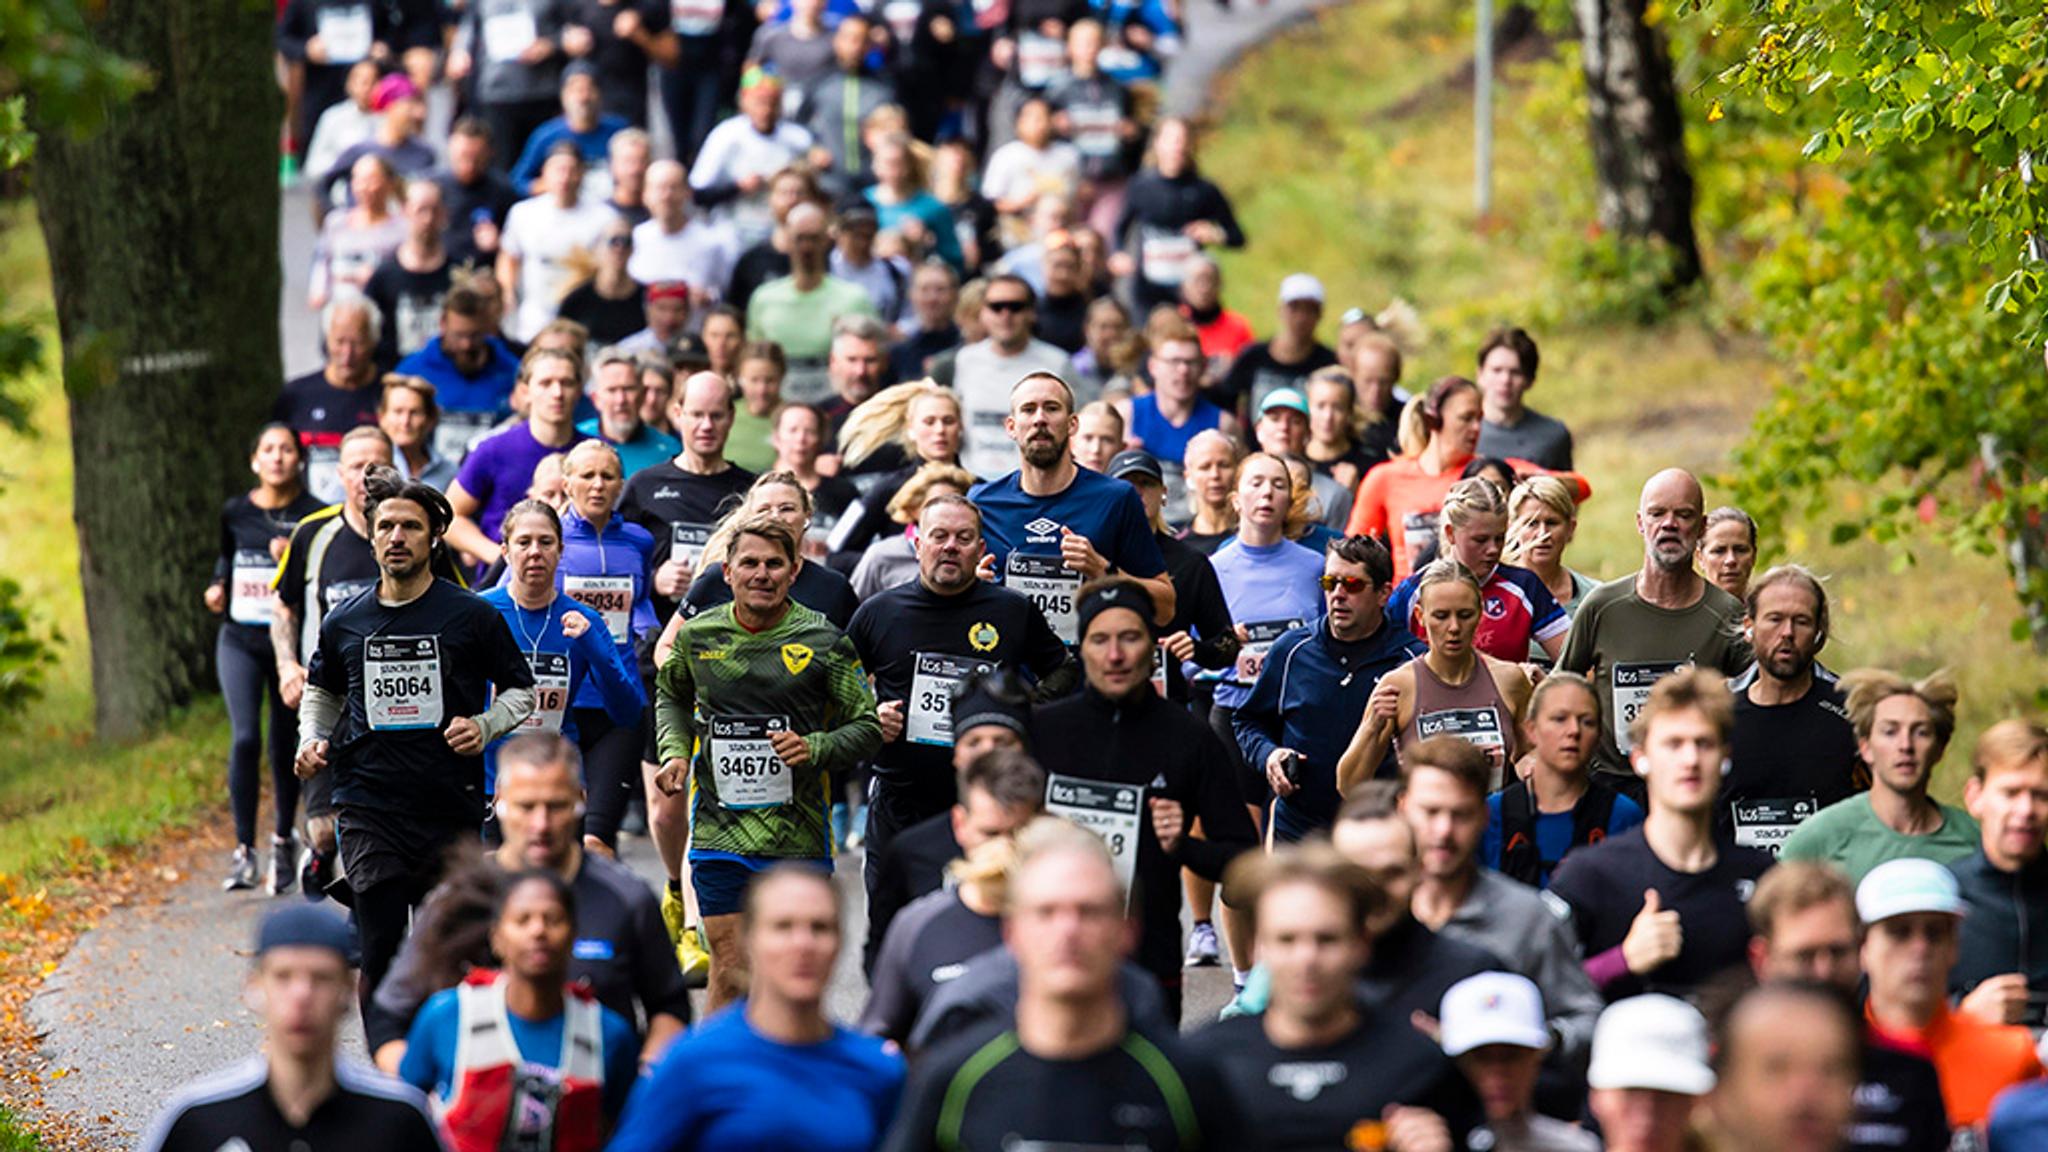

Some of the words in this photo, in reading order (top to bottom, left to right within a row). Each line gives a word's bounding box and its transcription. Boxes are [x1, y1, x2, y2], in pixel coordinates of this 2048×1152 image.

[1025, 535, 1057, 543] umbro
[1010, 559, 1028, 573] tcs
[242, 583, 275, 598] 351
[1023, 581, 1063, 590] stadium
[380, 664, 421, 673] stadium
[921, 658, 940, 673] tcs
[1617, 670, 1637, 684] tcs
[373, 677, 432, 698] 35064
[539, 692, 559, 710] 16
[920, 692, 950, 713] 35
[714, 722, 732, 736] tcs
[1422, 720, 1444, 734] tcs
[720, 756, 781, 776] 34676
[1738, 808, 1758, 822] tcs
